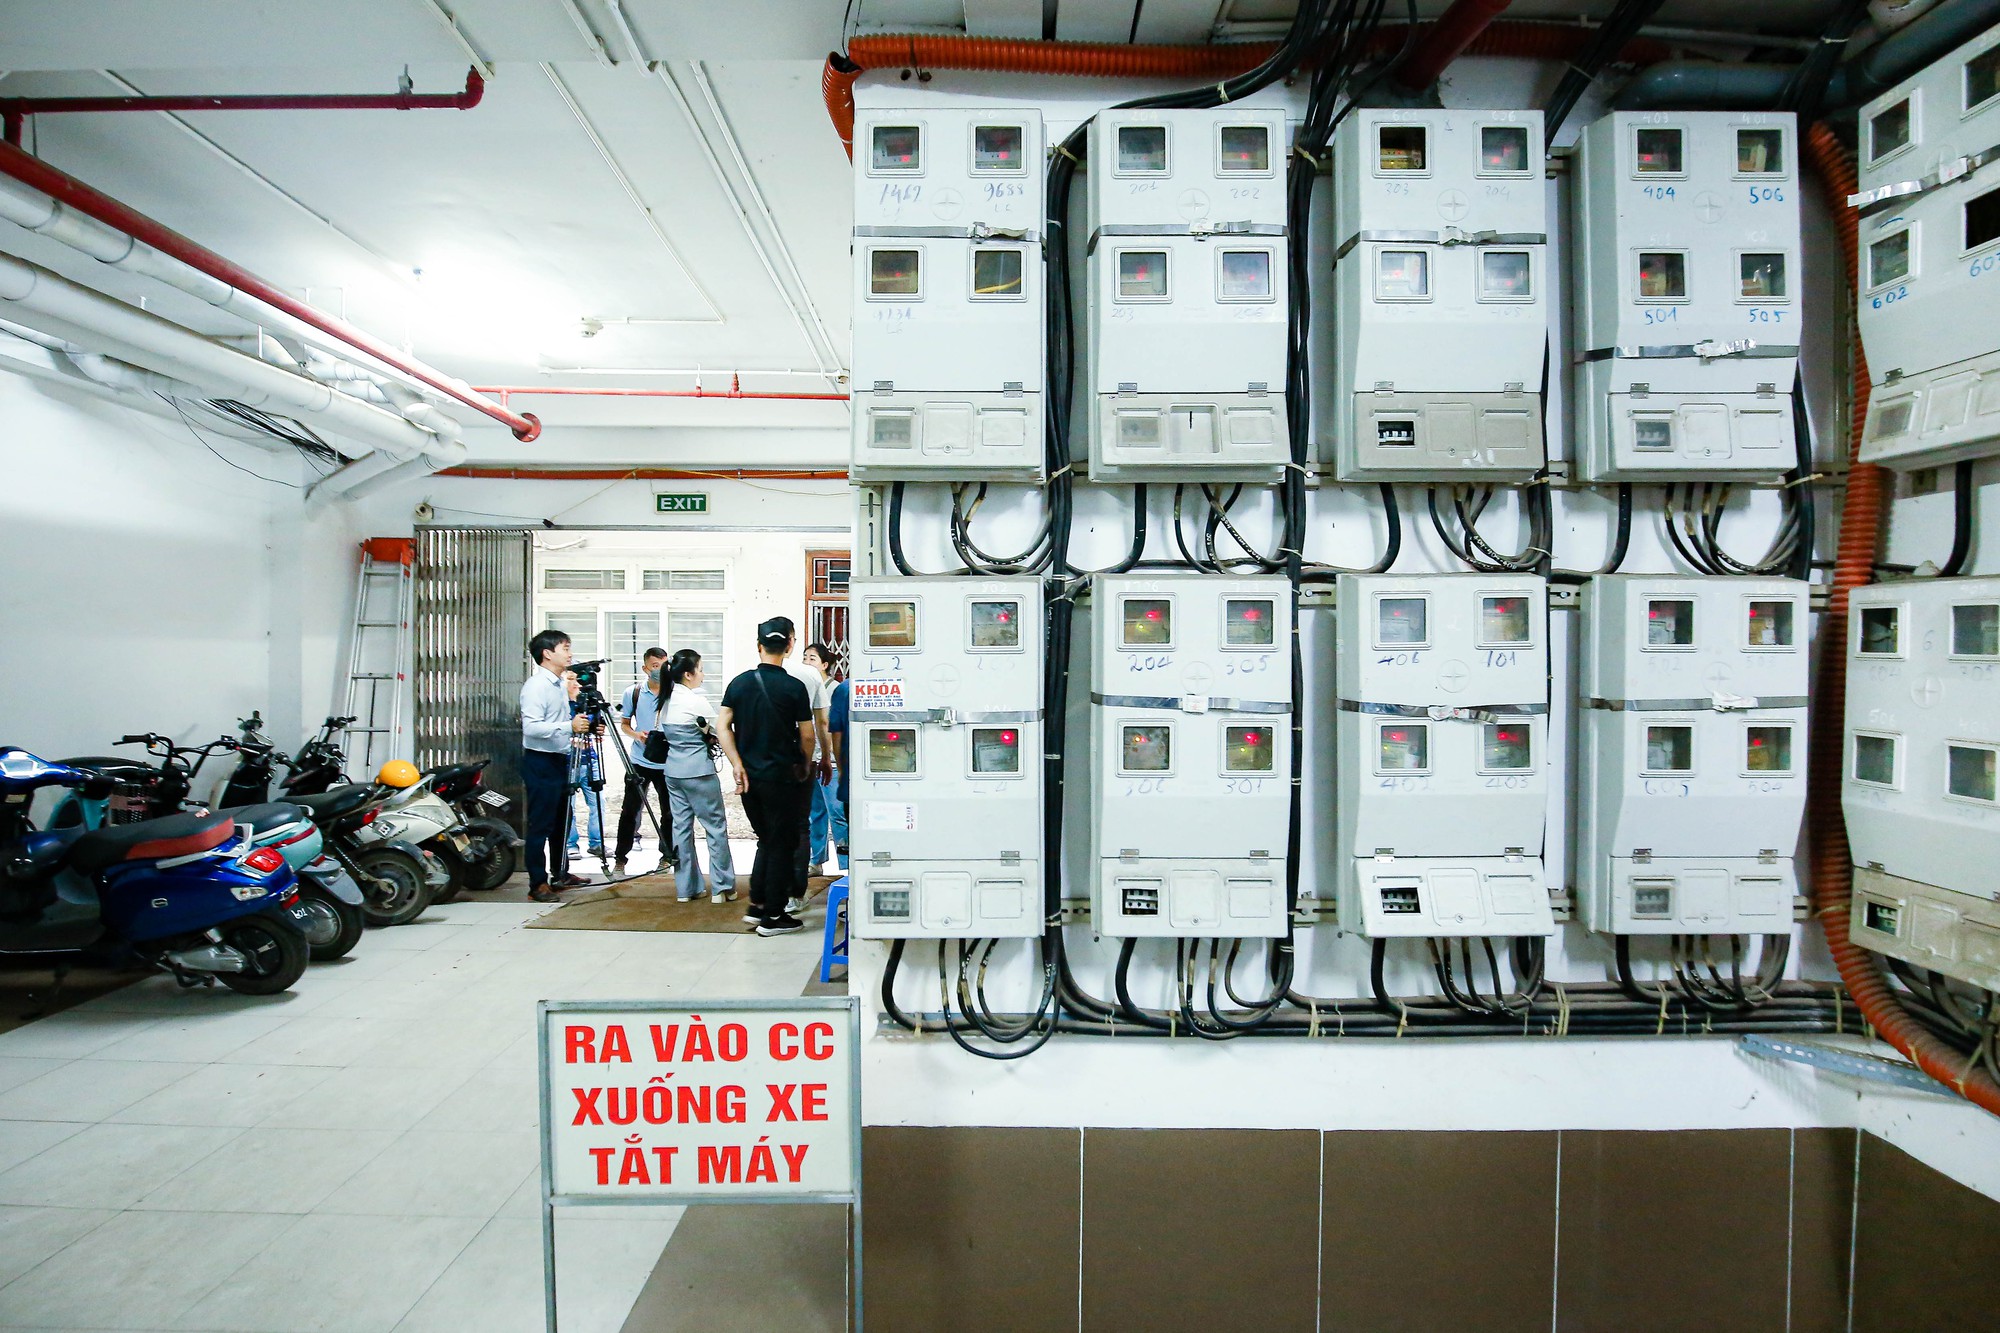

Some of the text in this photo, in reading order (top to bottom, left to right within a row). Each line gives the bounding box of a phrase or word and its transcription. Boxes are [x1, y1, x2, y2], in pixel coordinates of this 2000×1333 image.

[1642, 186, 1676, 202] 404
[1749, 186, 1784, 204] 506
[1872, 286, 1909, 310] 602
[1644, 307, 1678, 325] 501
[1749, 308, 1788, 323] 505
[660, 497, 704, 510] EXIT
[855, 682, 901, 696] KHÓA
[565, 1014, 834, 1064] RA VÀO CC
[571, 1072, 829, 1126] XUỐNG XE
[588, 1133, 809, 1186] TẮT MÁY
